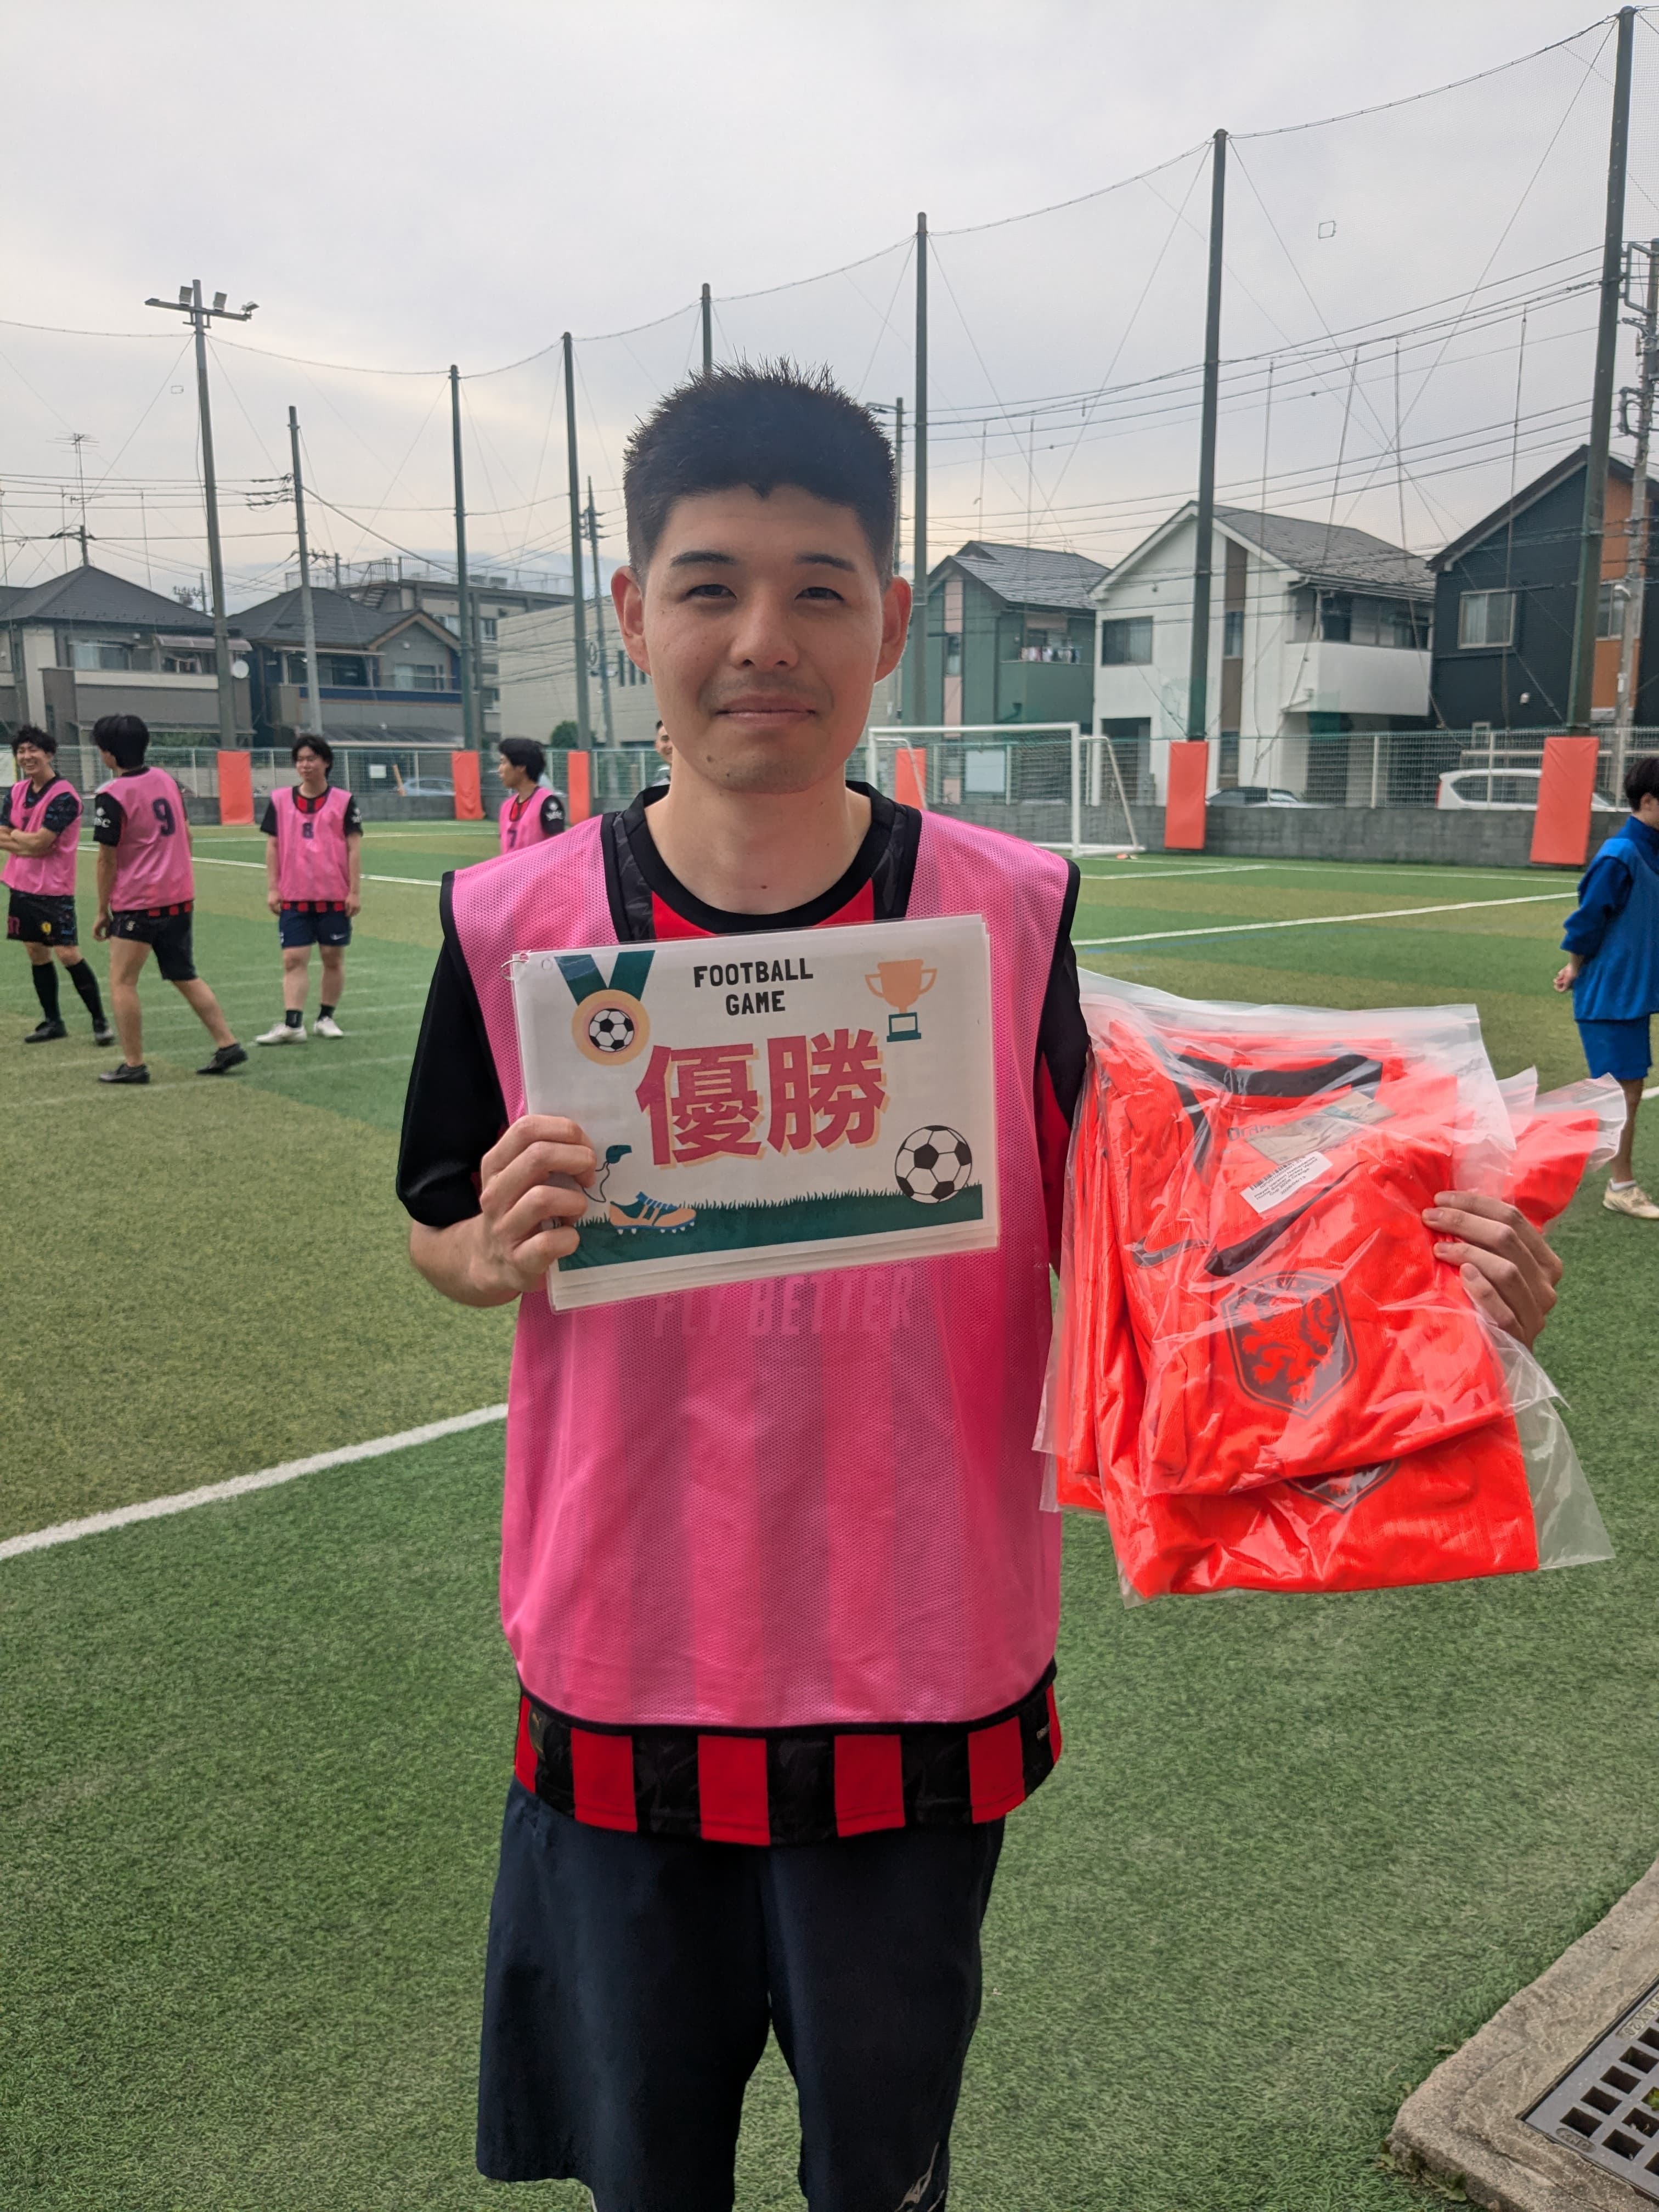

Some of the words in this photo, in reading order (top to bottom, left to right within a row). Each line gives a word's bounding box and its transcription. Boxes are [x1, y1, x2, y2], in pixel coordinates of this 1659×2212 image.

[153, 798, 176, 836] 9
[693, 958, 814, 988] FOOTBALL
[726, 990, 786, 1016] GAME
[635, 1029, 886, 1167] 優勝
[747, 1268, 914, 1335] BETTER
